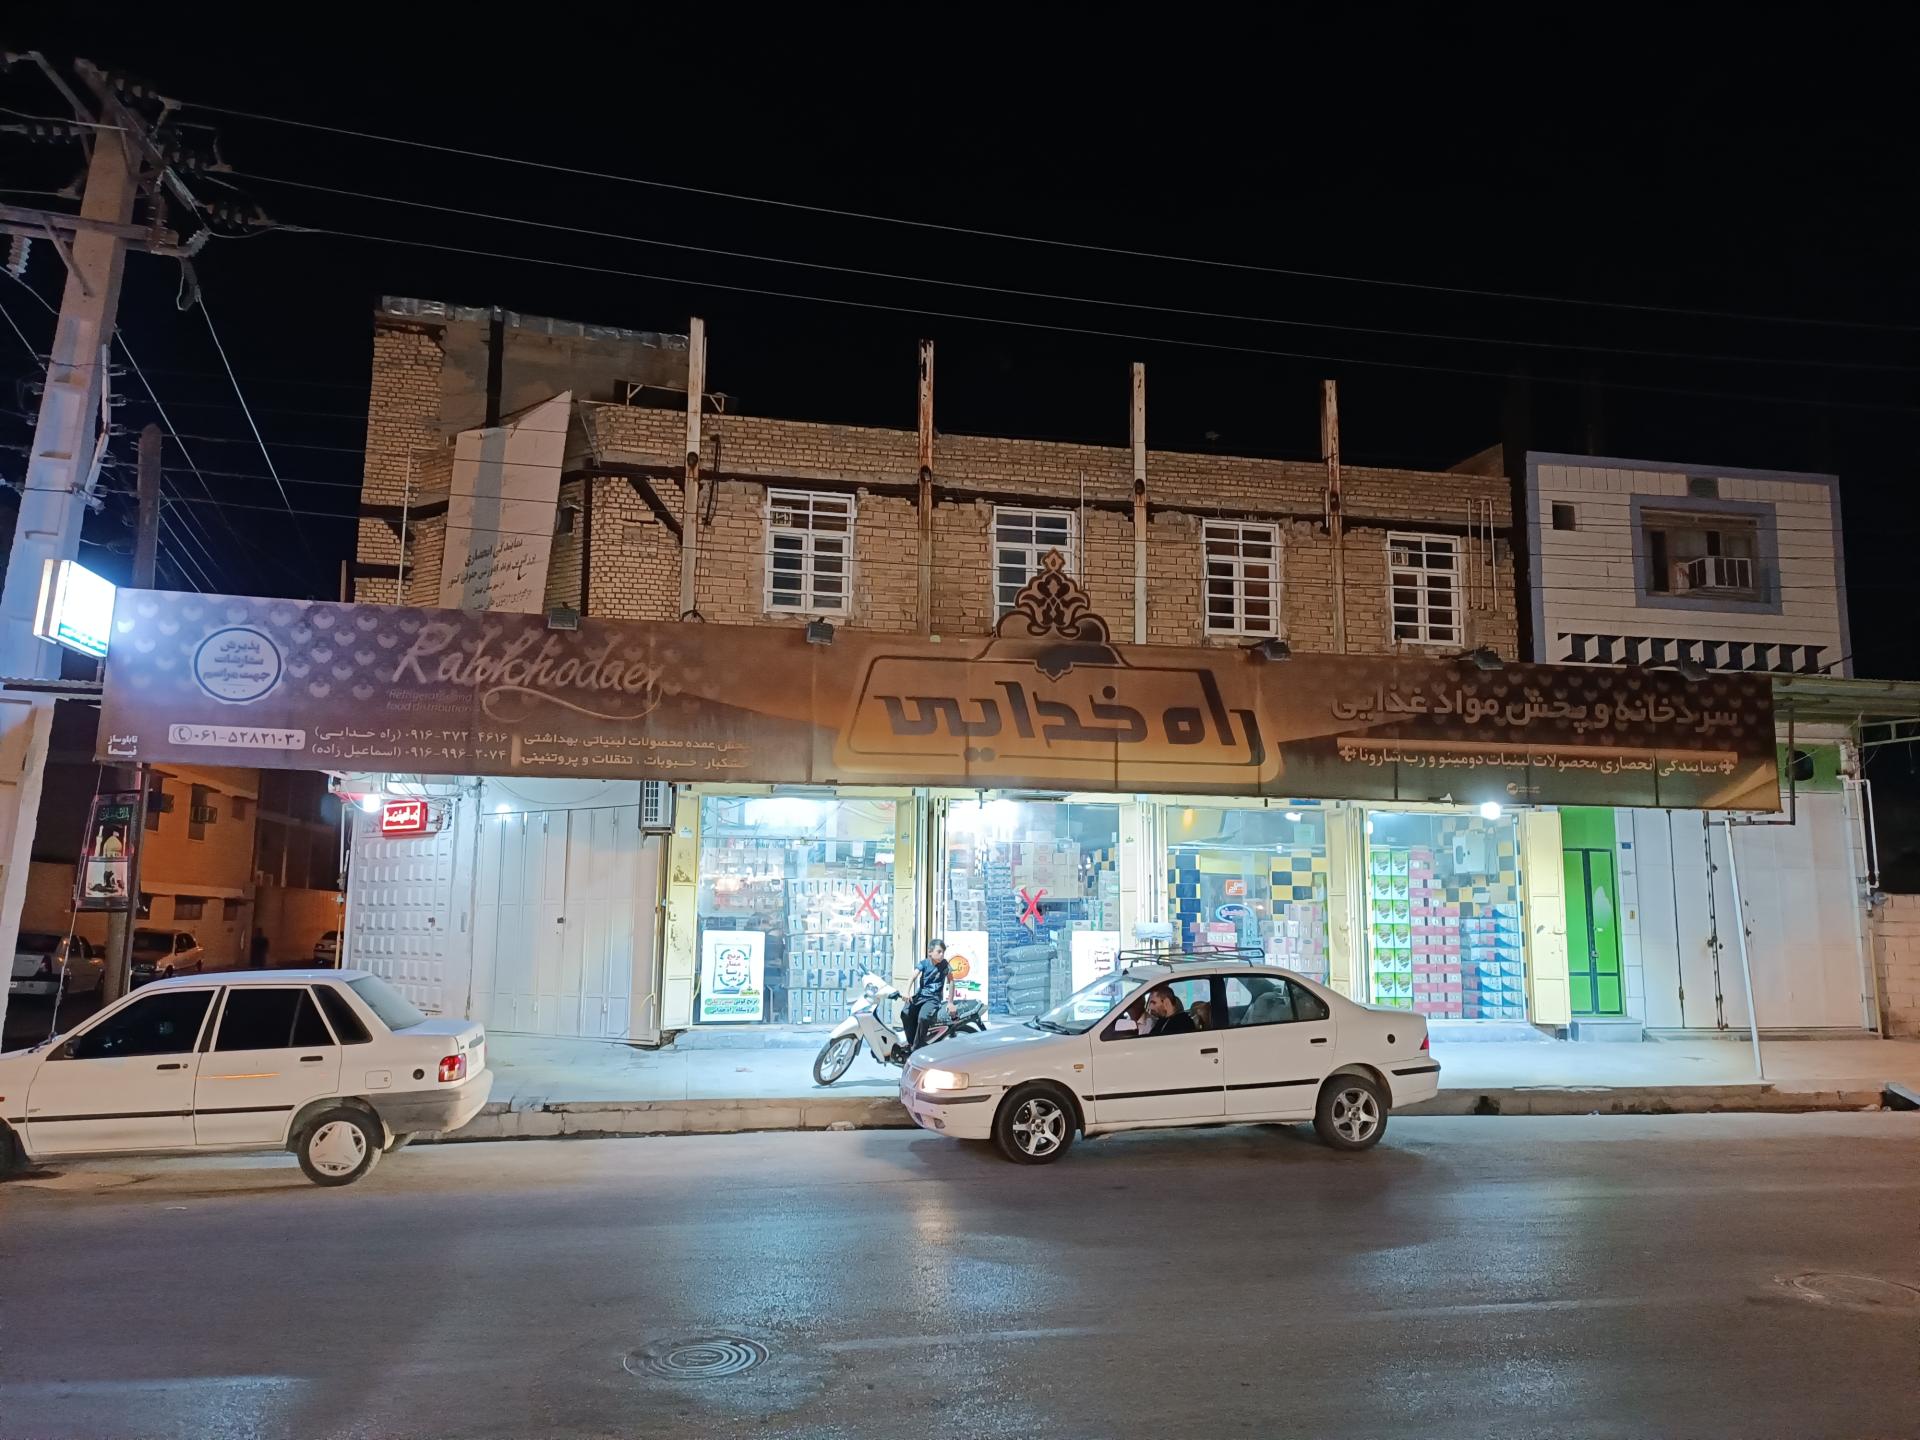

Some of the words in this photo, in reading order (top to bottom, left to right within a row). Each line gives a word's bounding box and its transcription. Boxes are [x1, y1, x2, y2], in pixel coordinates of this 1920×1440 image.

[220, 640, 260, 653] پذیرش
[214, 654, 264, 668] سفارشات
[203, 667, 238, 682] مراسم
[239, 671, 271, 682] جهت
[1330, 684, 1428, 721] غذایی
[1434, 690, 1499, 725] مواد
[1163, 668, 1266, 766] راه
[1505, 688, 1587, 734] پخش
[1594, 702, 1609, 729] و
[1615, 694, 1738, 733] سردخانه
[873, 680, 1149, 763] خدایی
[314, 726, 375, 741] خدایی)
[380, 727, 402, 742] (راه
[523, 733, 578, 746] بهداشتی
[107, 745, 137, 757] نیما
[311, 743, 341, 758] زاده)
[628, 737, 683, 750] محصولات
[685, 740, 715, 749] عمده
[344, 745, 402, 758] (اسماعیل
[1358, 746, 1401, 767] شارونا
[521, 752, 579, 768] پروتئینی
[581, 757, 589, 767] و
[591, 754, 634, 765] تنقلات
[1403, 754, 1426, 767] رب
[1428, 758, 1436, 768] و
[1438, 751, 1483, 769] دومینو
[1485, 752, 1531, 770] لبنیات
[1532, 753, 1598, 773] محصولات
[1600, 754, 1655, 775] انحصاری
